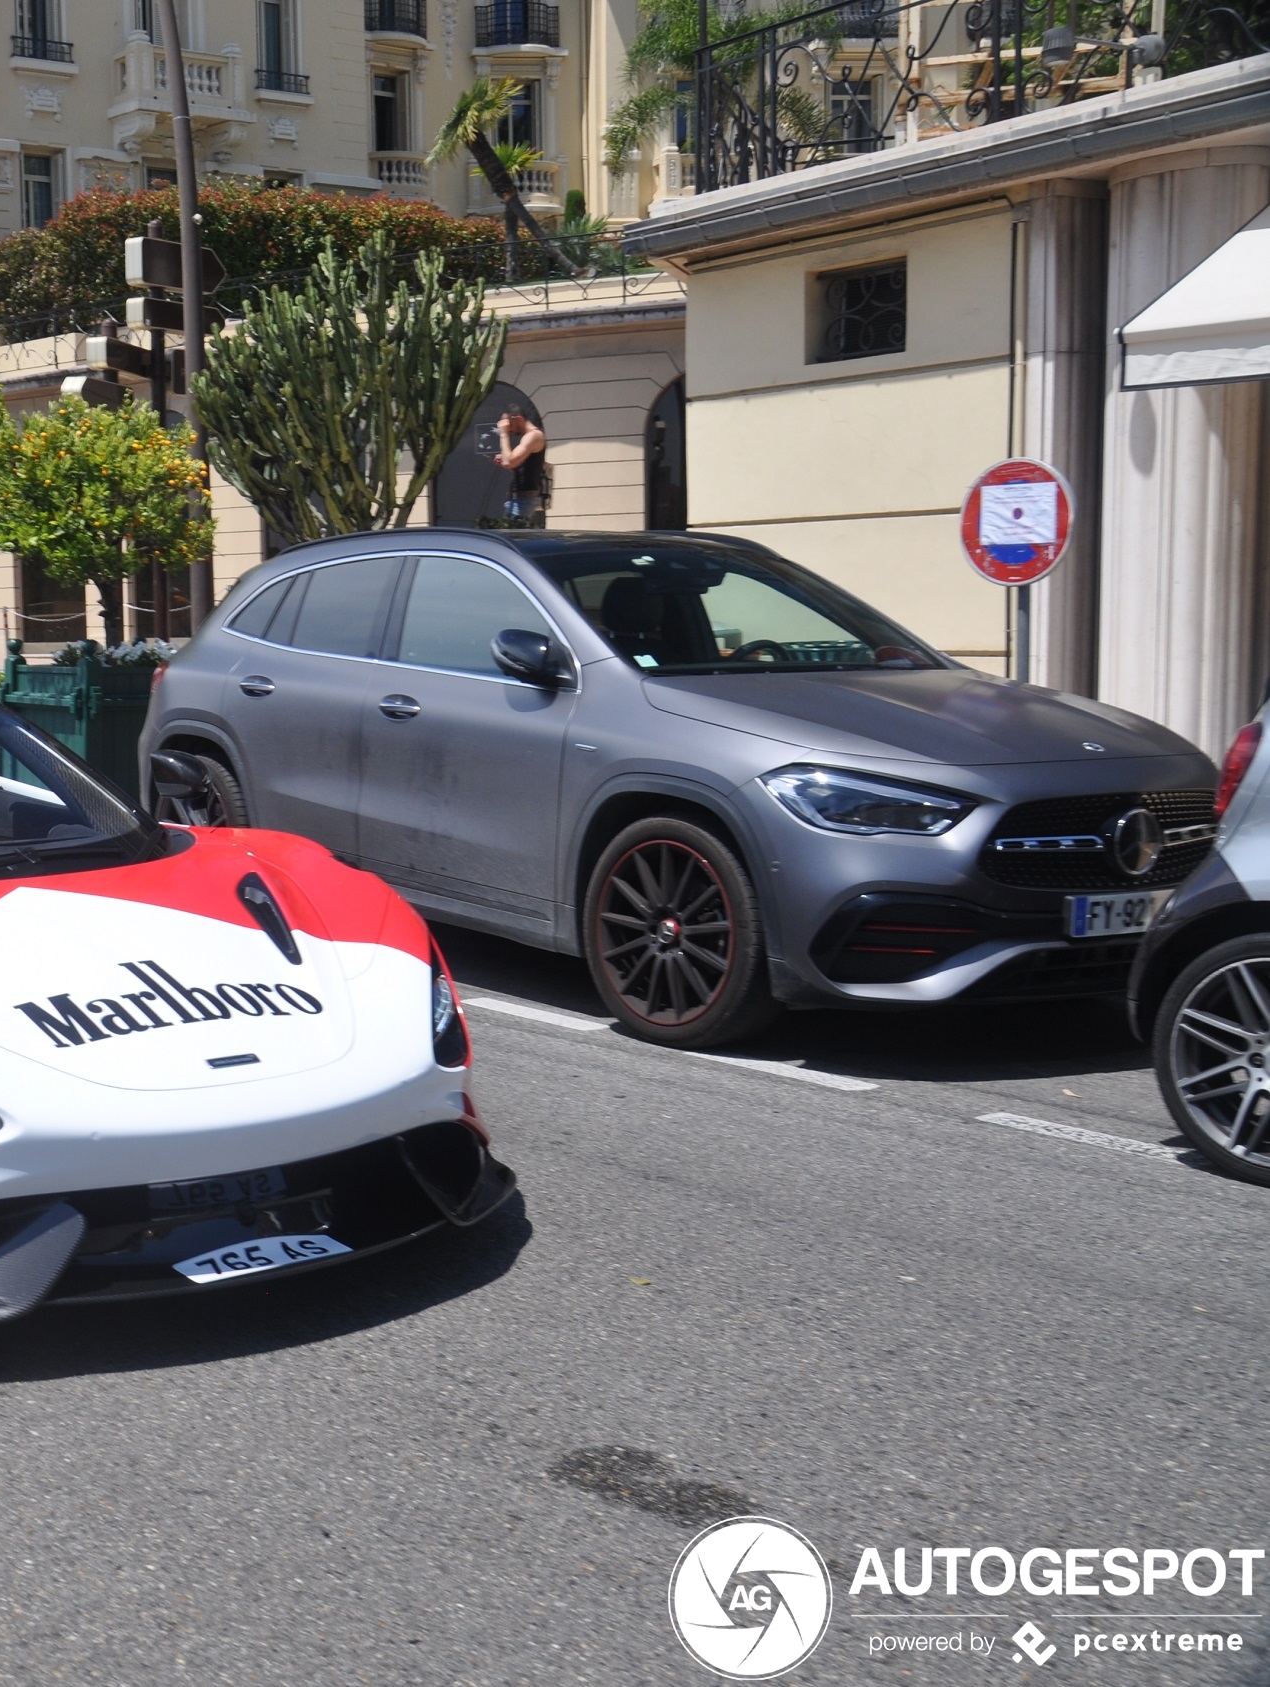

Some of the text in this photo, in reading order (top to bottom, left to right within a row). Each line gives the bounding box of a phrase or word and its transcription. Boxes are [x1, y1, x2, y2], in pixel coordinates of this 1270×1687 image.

[13, 959, 323, 1049] Marlboro
[195, 1239, 329, 1275] 765 AS
